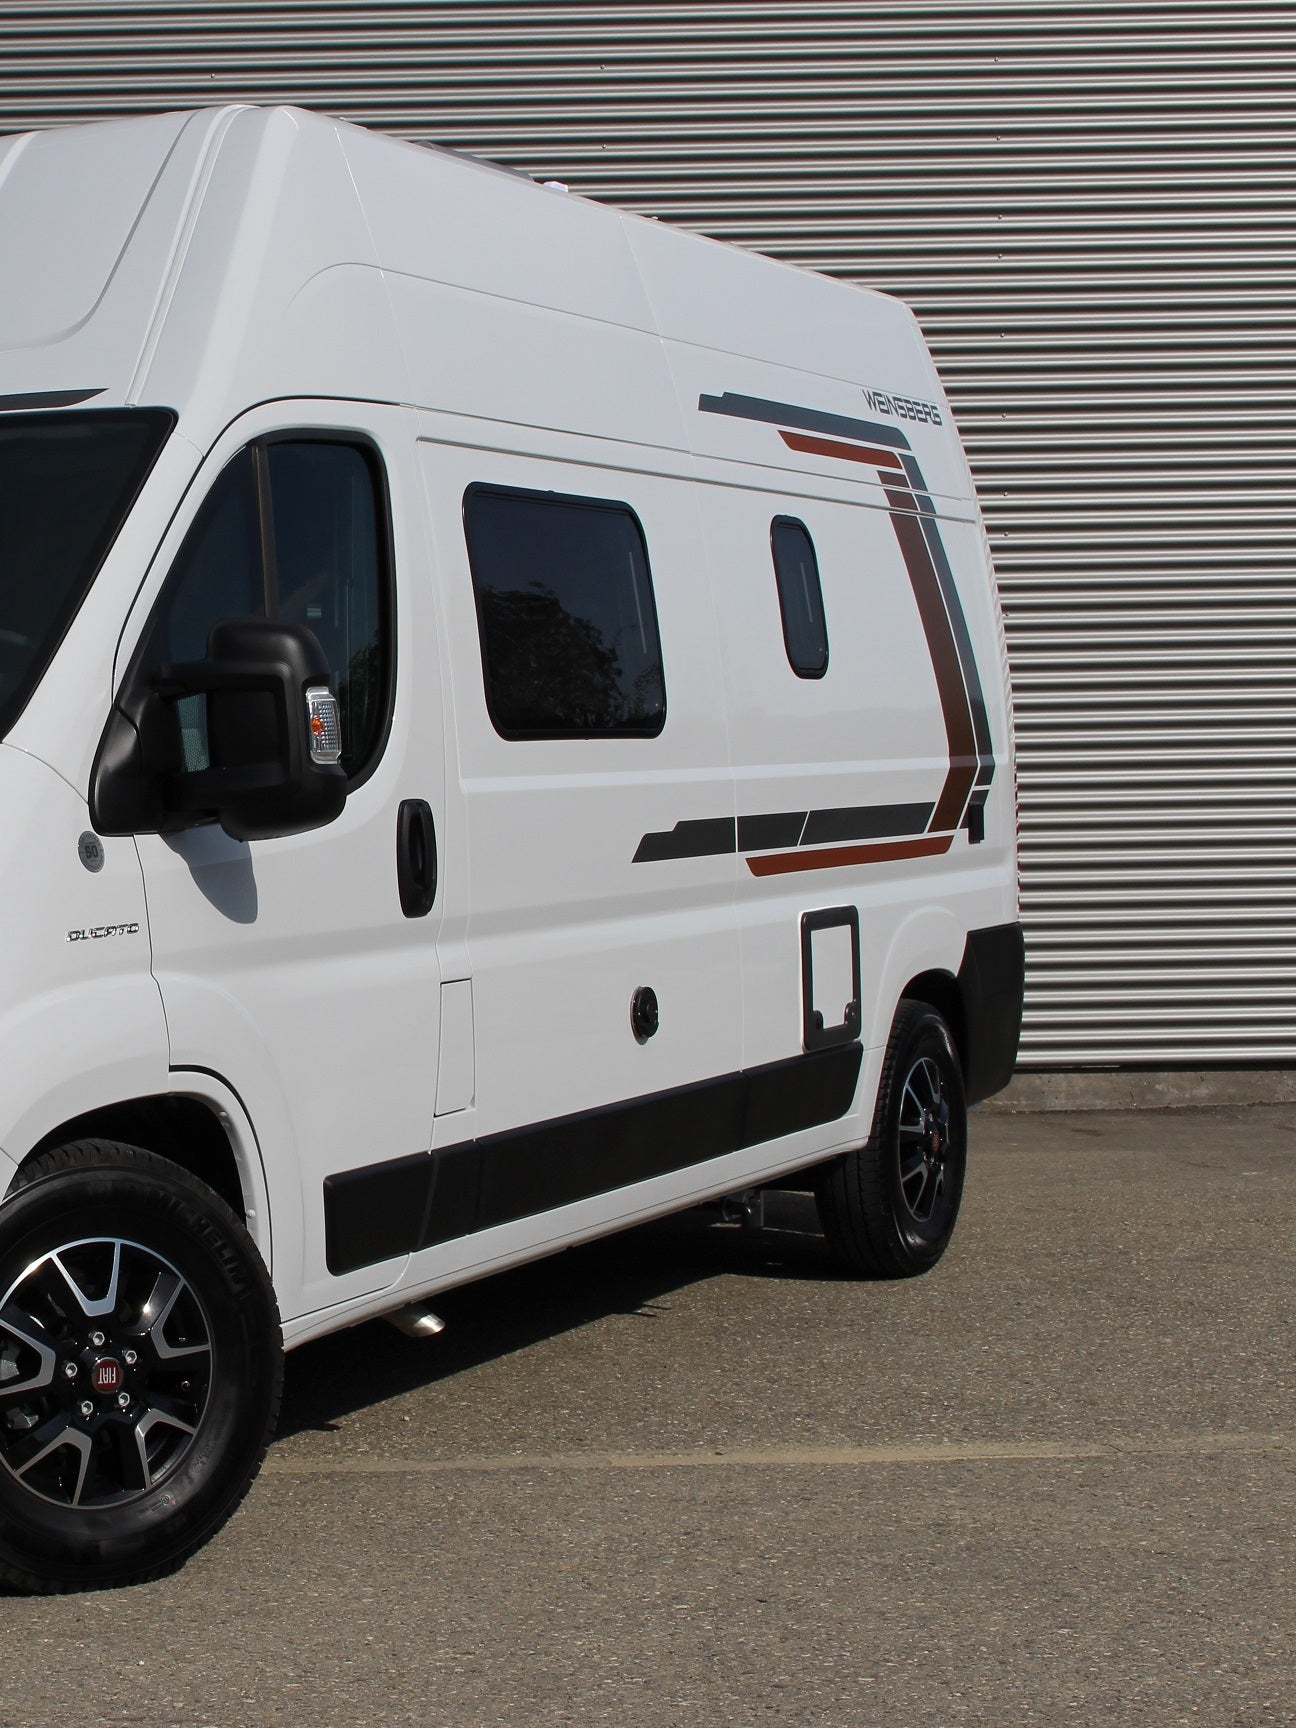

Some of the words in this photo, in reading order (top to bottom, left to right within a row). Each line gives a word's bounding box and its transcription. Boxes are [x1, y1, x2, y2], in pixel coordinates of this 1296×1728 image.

[861, 388, 943, 426] WEINSBERG
[66, 923, 140, 942] DUCATO
[97, 1367, 117, 1385] FIAT
